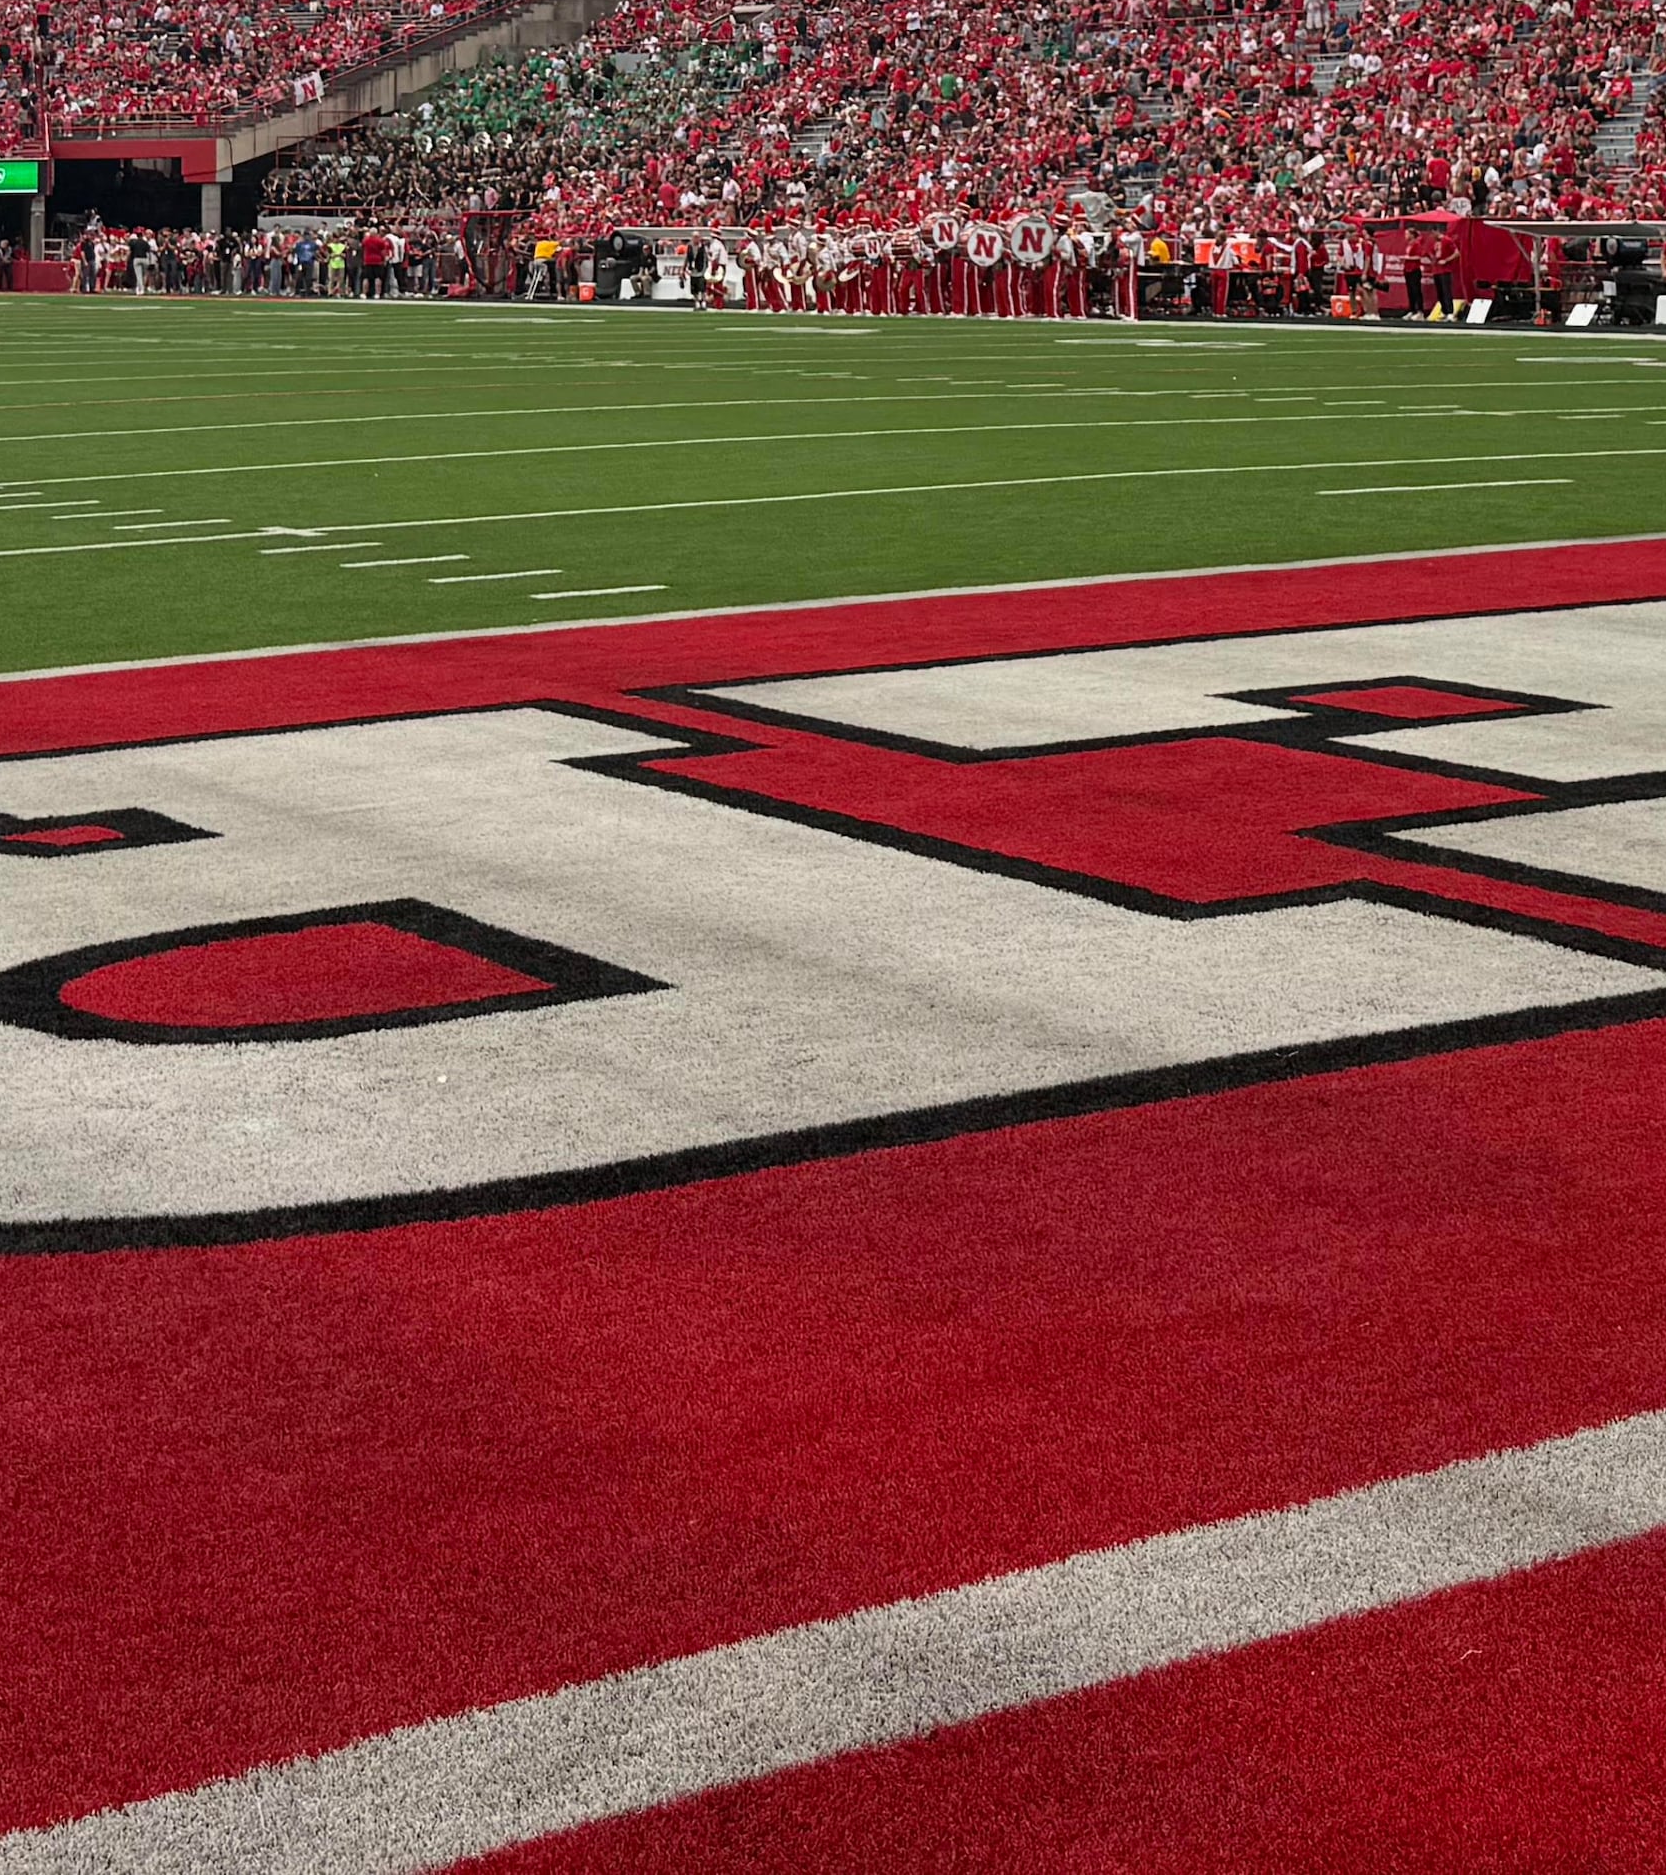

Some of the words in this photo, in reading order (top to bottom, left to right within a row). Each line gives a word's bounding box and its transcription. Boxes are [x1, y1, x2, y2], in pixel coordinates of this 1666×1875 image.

[939, 222, 953, 242] N
[1019, 226, 1046, 253] N
[974, 234, 997, 258] N
